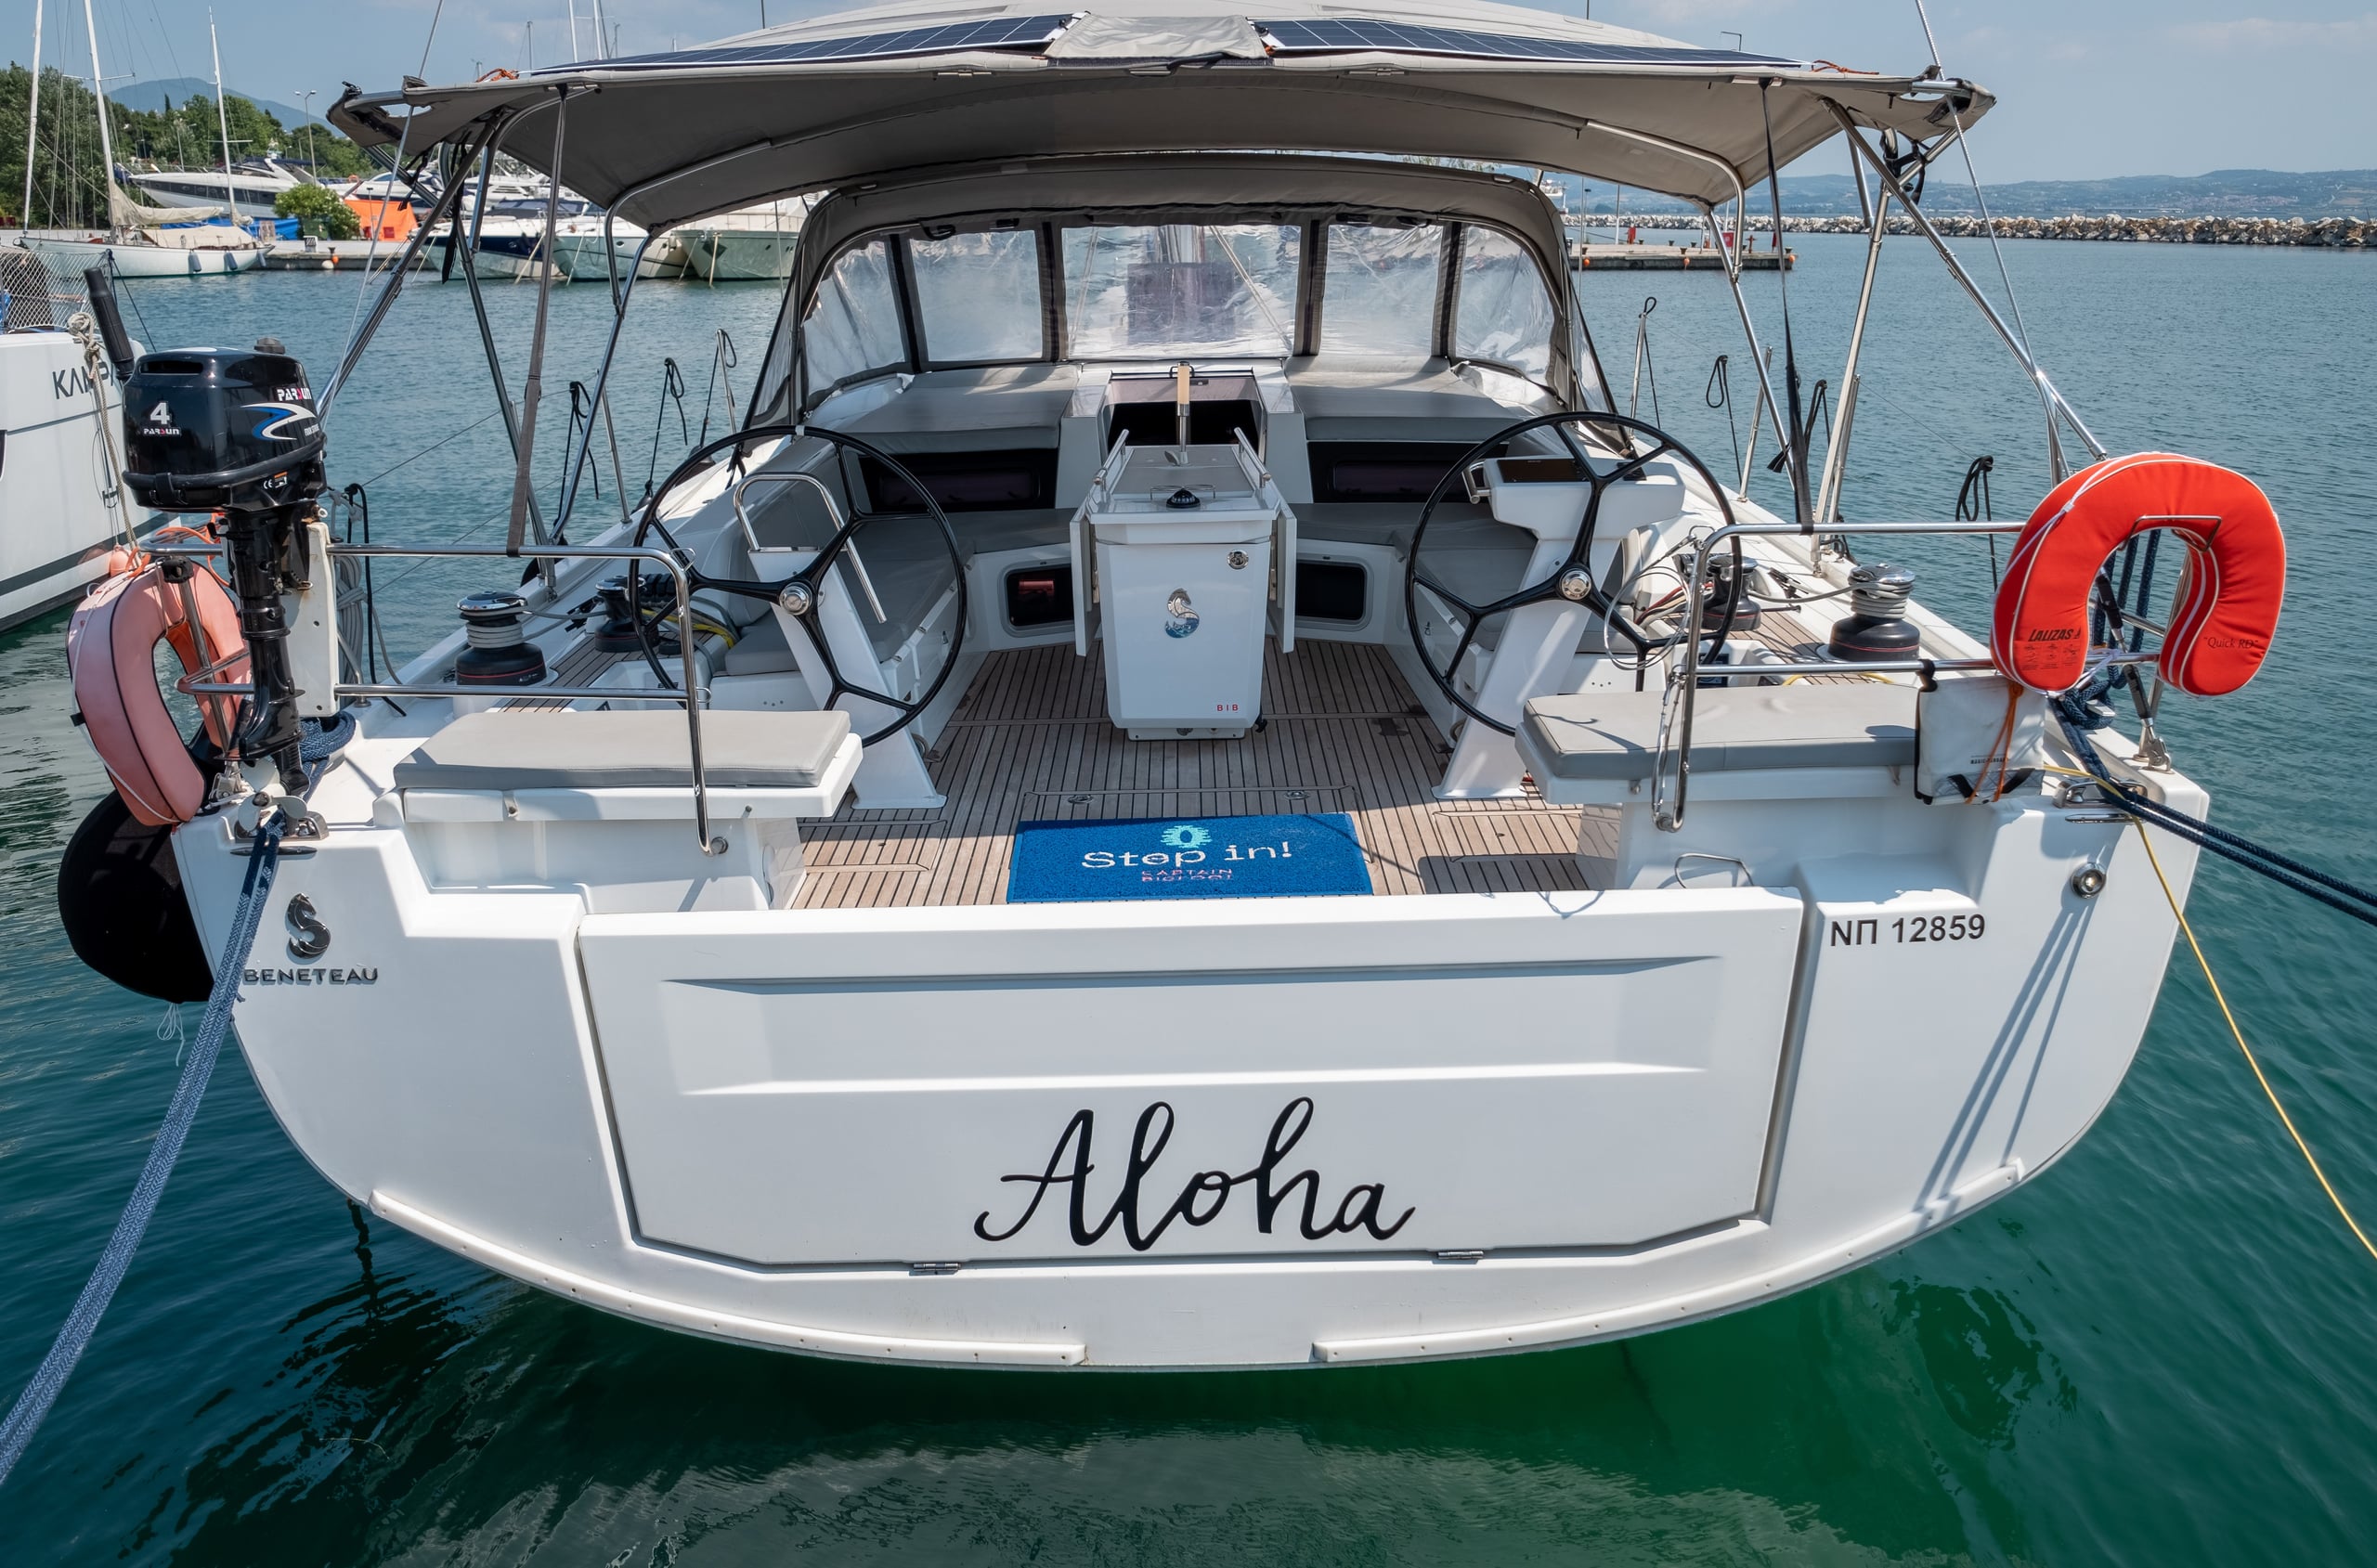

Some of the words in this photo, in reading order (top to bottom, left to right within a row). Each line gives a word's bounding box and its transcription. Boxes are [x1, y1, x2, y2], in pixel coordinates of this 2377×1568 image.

[150, 402, 170, 424] 4
[2028, 628, 2074, 641] LALIZAS
[1082, 849, 1206, 868] Step
[1224, 841, 1292, 861] in!
[1891, 914, 1985, 943] 12859
[243, 967, 379, 983] BENETEAU
[974, 1096, 1416, 1251] Aloha
